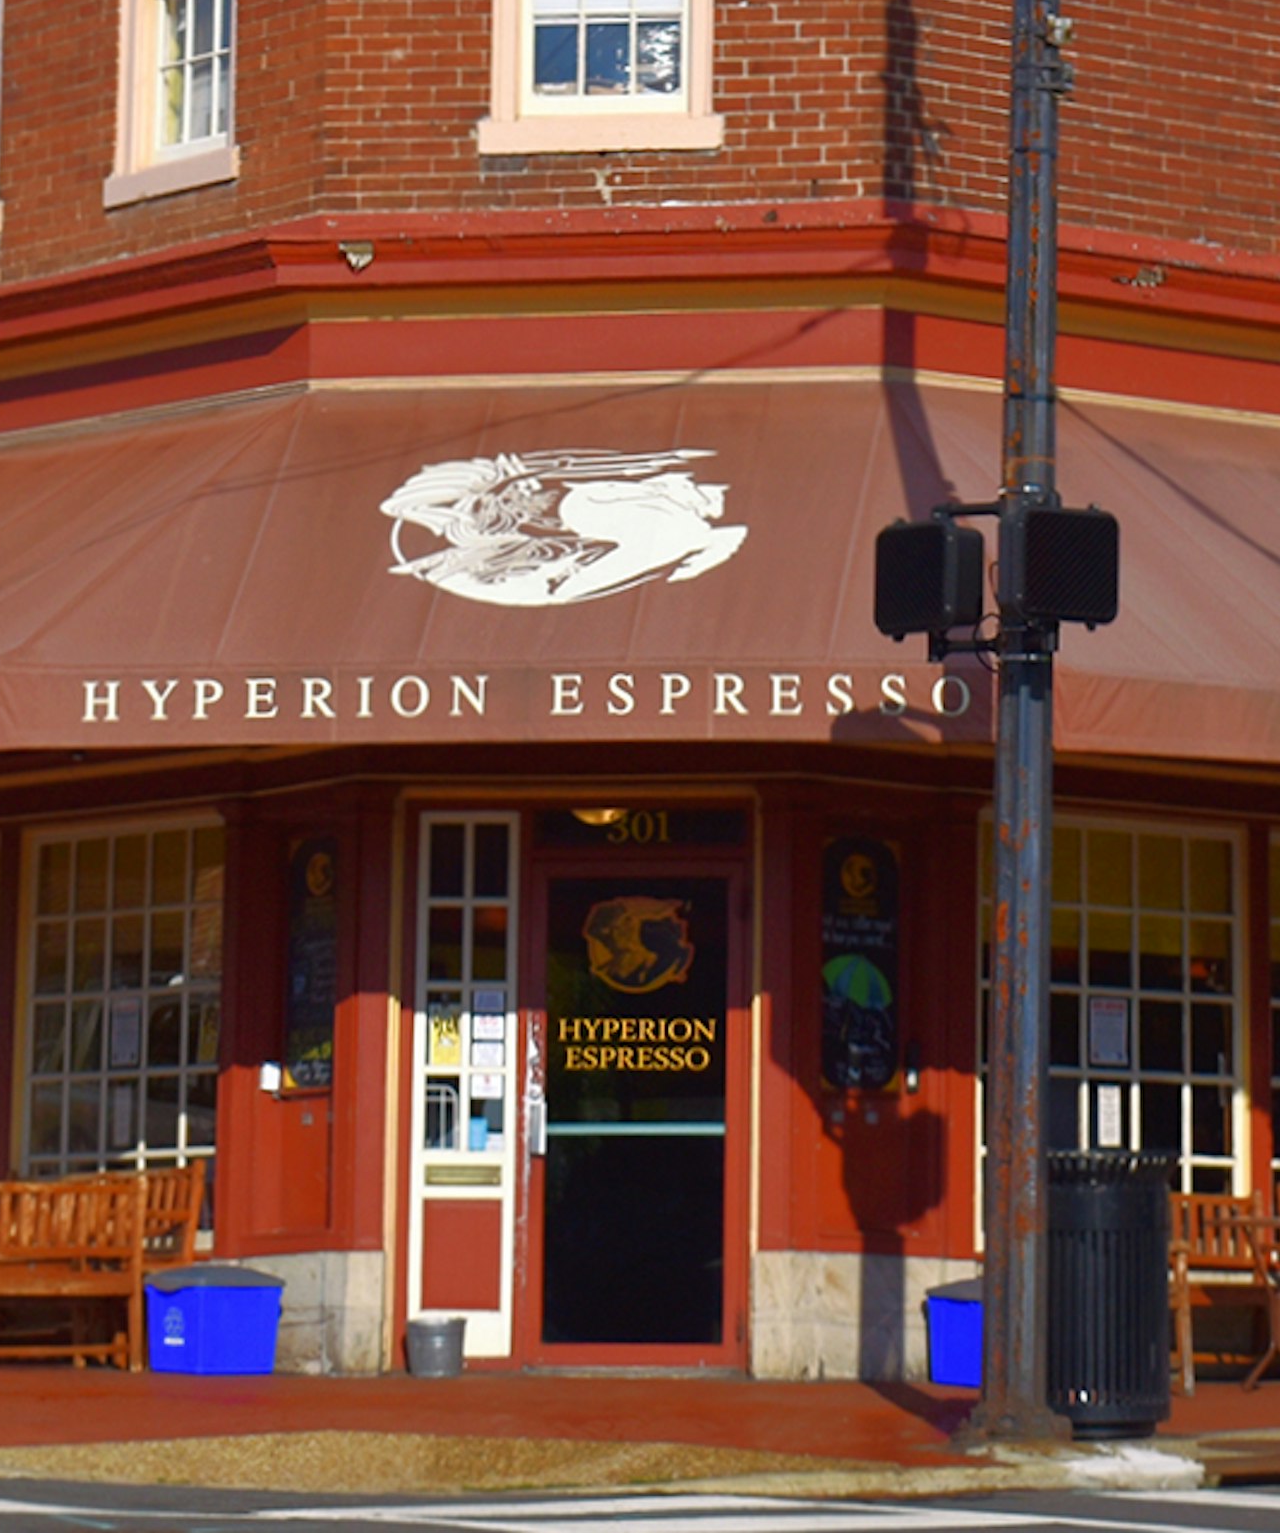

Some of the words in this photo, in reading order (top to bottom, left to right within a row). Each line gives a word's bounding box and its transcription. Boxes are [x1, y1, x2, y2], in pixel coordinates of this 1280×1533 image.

[81, 674, 490, 723] HYPERION
[550, 671, 973, 719] ESPRESSO
[607, 809, 671, 844] 301
[558, 1018, 717, 1043] HYPERION
[565, 1046, 711, 1071] ESPRESSO
